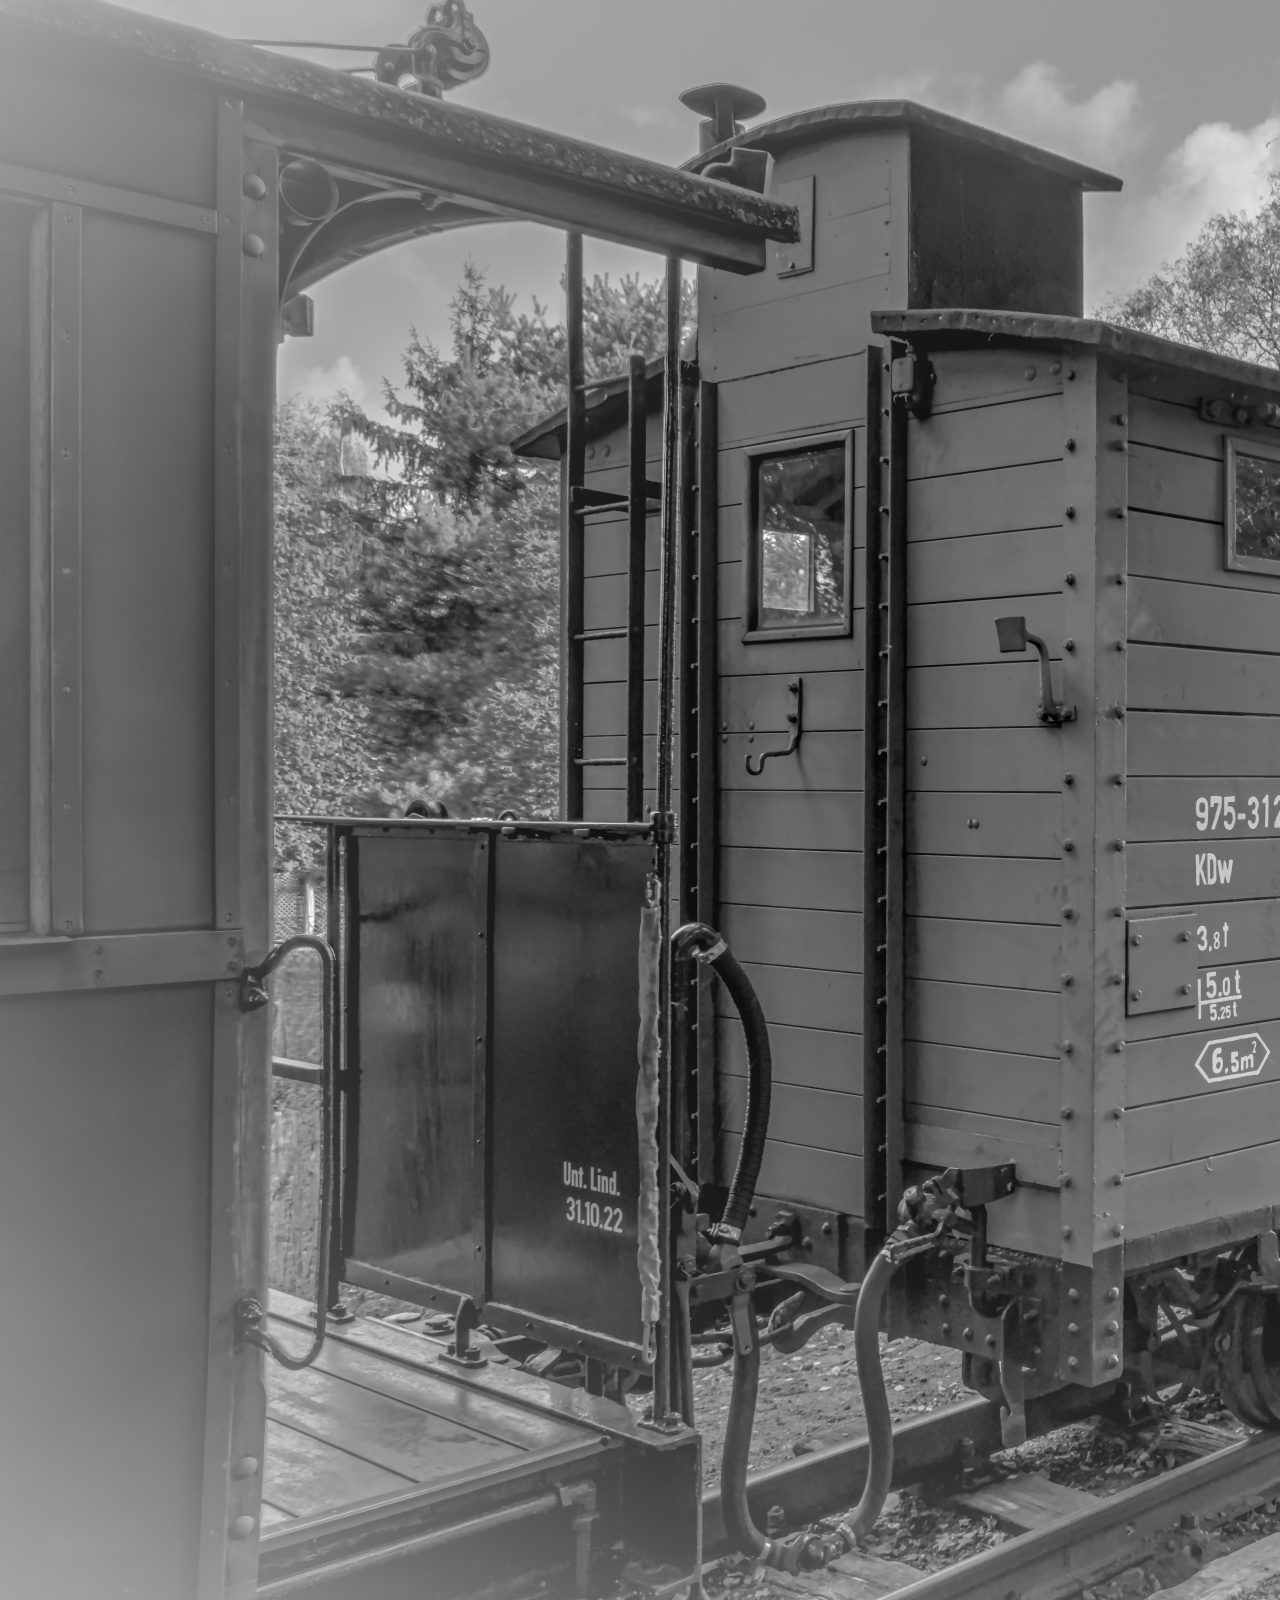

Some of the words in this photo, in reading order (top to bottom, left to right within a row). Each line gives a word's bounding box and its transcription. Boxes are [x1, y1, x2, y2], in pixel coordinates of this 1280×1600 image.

[1195, 852, 1234, 886] KDw
[563, 1161, 587, 1189] Unt.
[590, 1166, 620, 1196] Lind.
[566, 1196, 623, 1233] 31.10.22
